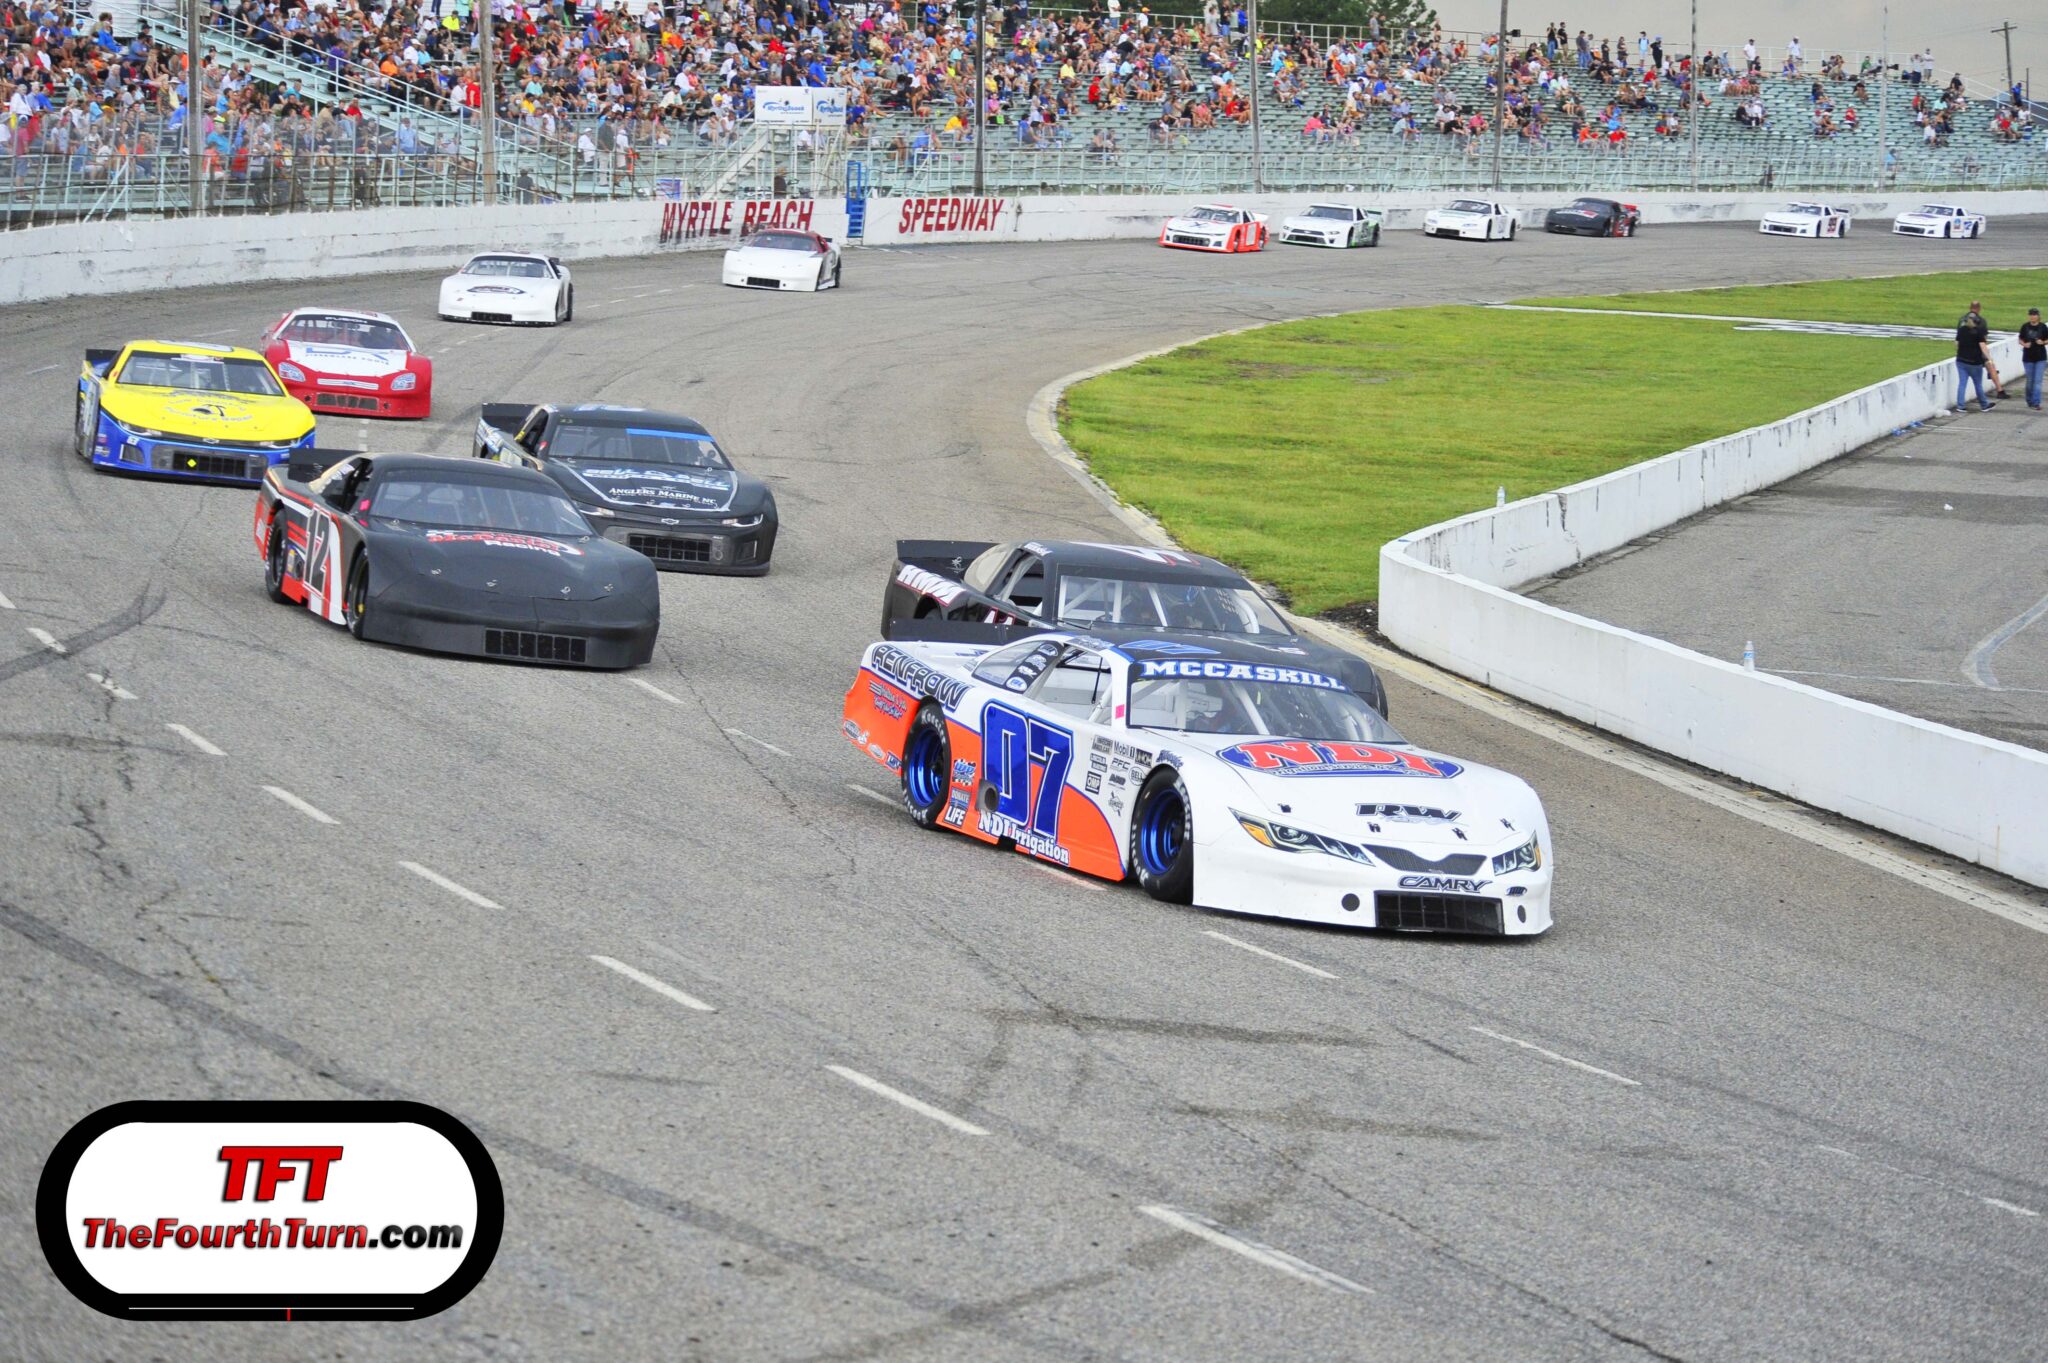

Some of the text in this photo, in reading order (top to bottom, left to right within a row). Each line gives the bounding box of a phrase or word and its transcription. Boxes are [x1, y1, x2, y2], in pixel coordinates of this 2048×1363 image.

[659, 198, 1005, 244] MYRTLE BEACH SPEEDWAY
[609, 487, 656, 496] ANGLERS
[658, 490, 700, 502] MARINE
[872, 644, 972, 713] RENFROW
[1140, 660, 1347, 692] MCCASKILL
[980, 698, 1075, 842] 07
[1237, 741, 1443, 776] NDI
[944, 805, 967, 826] LIFE
[978, 810, 1070, 866] NDI Irrigation
[1398, 875, 1493, 893] CAMRY
